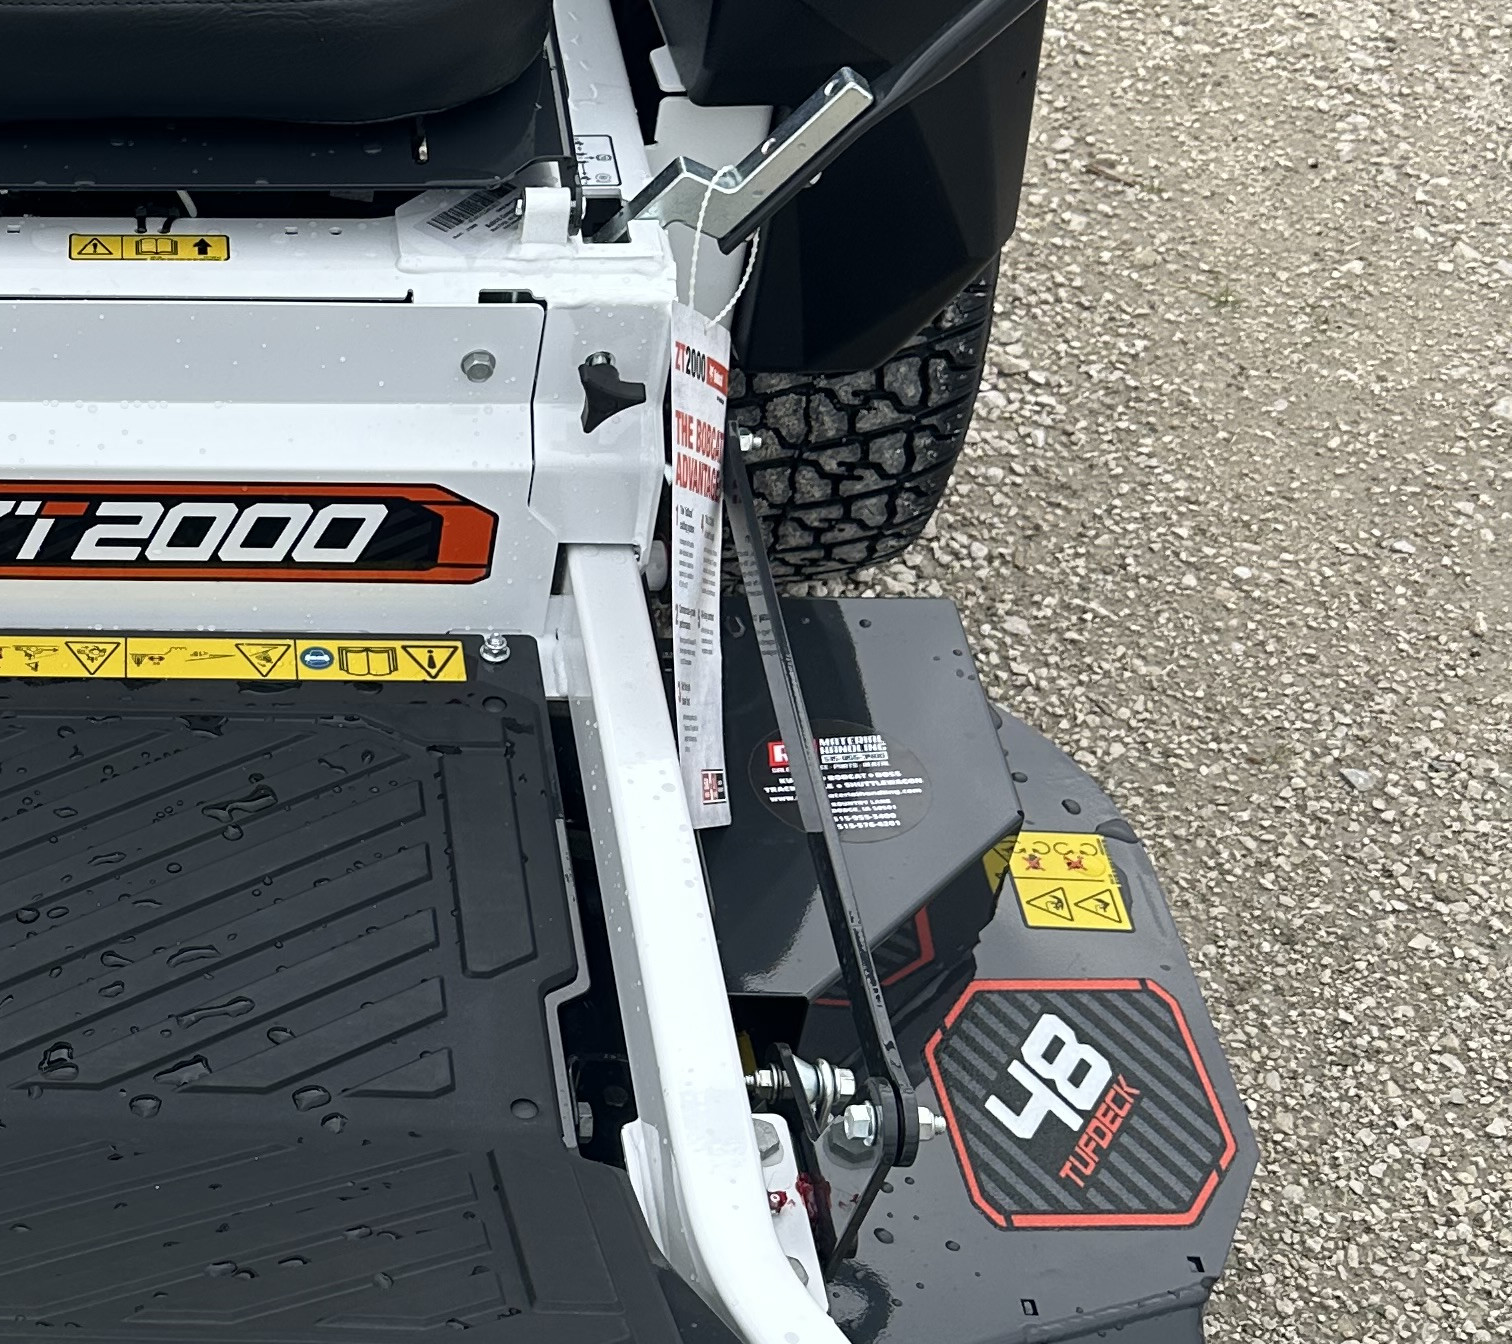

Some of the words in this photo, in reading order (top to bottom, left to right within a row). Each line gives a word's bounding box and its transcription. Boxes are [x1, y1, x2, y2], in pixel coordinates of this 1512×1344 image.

[675, 340, 706, 383] ZT2000
[675, 409, 694, 450] THE
[985, 1013, 1113, 1141] 48
[1058, 1074, 1140, 1189] TUFDECK
